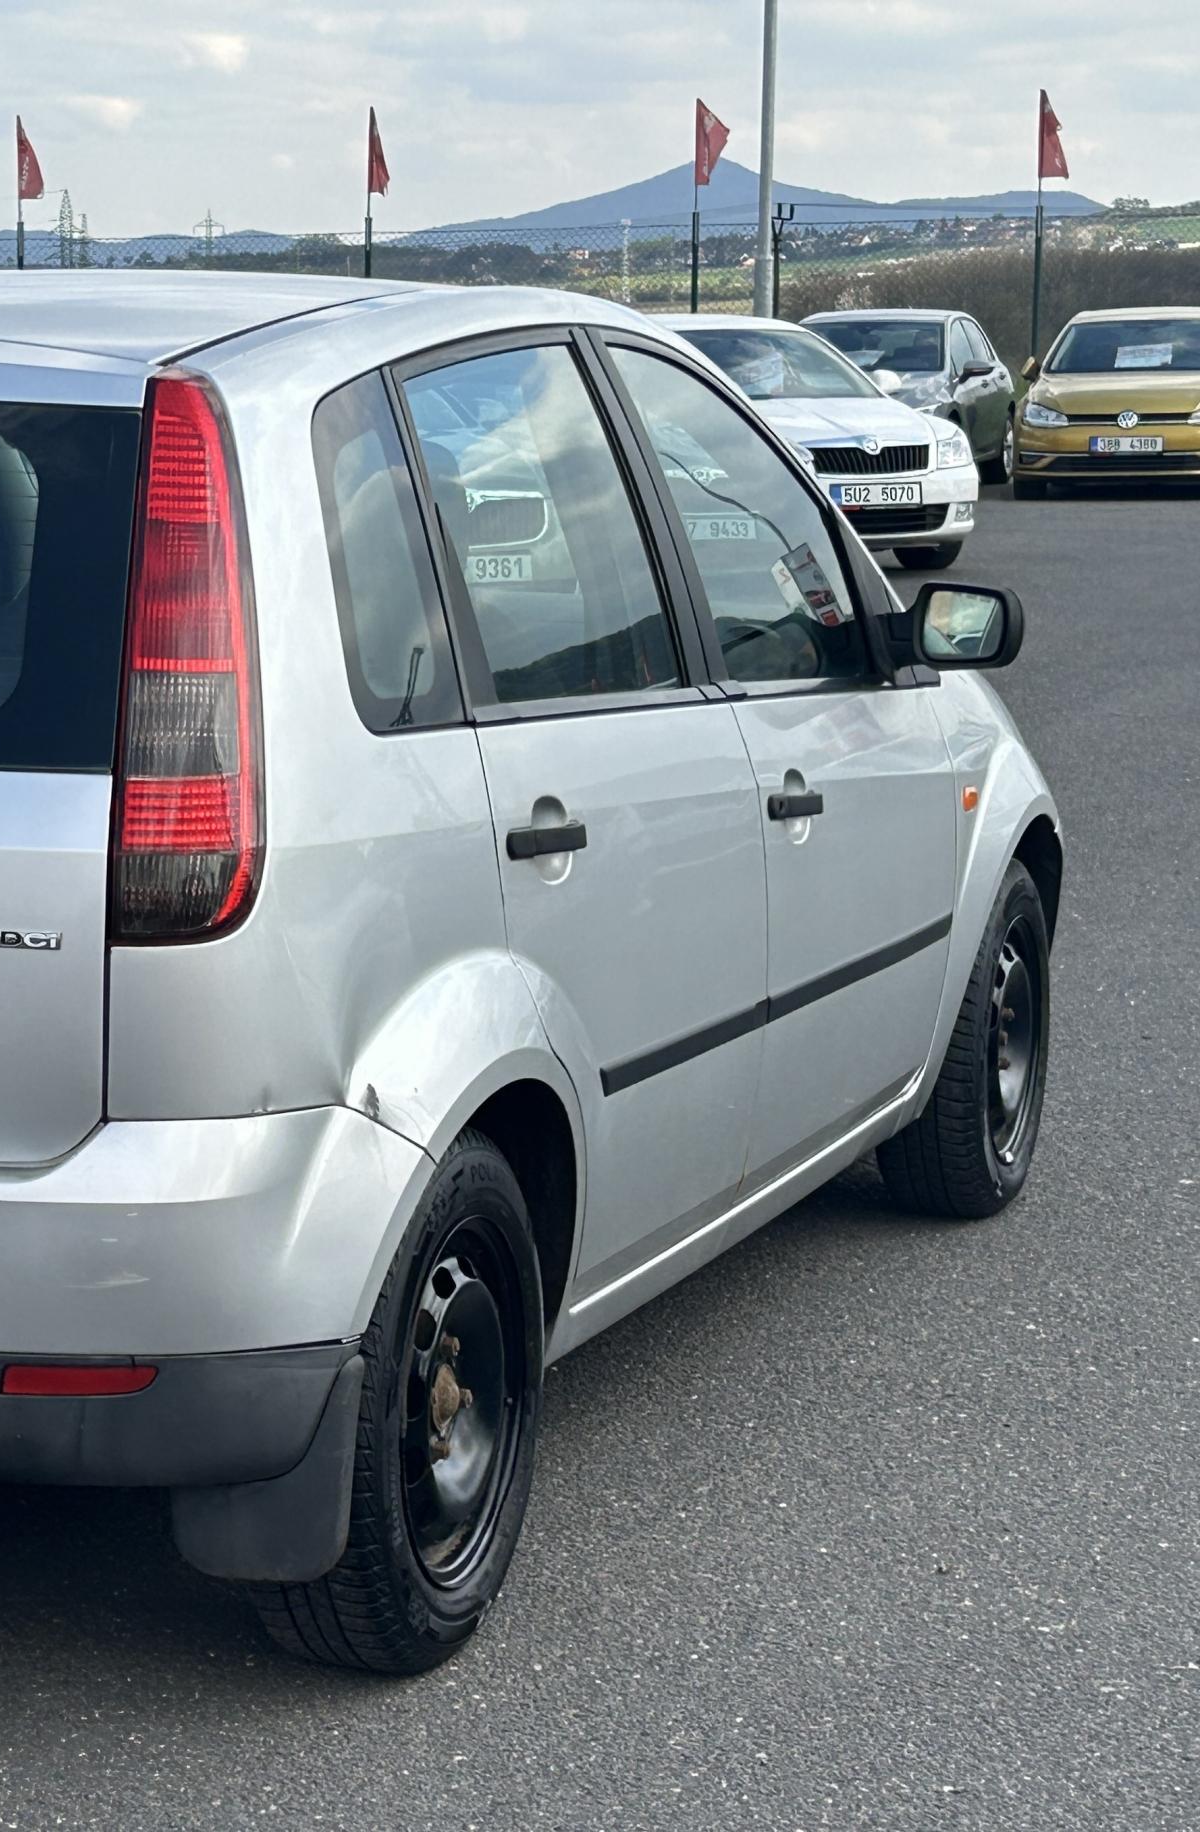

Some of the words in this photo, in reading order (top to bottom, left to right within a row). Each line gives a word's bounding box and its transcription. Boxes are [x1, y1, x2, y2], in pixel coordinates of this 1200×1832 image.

[844, 486, 870, 502] 5U2
[881, 486, 914, 501] 5070
[475, 557, 523, 579] 9361
